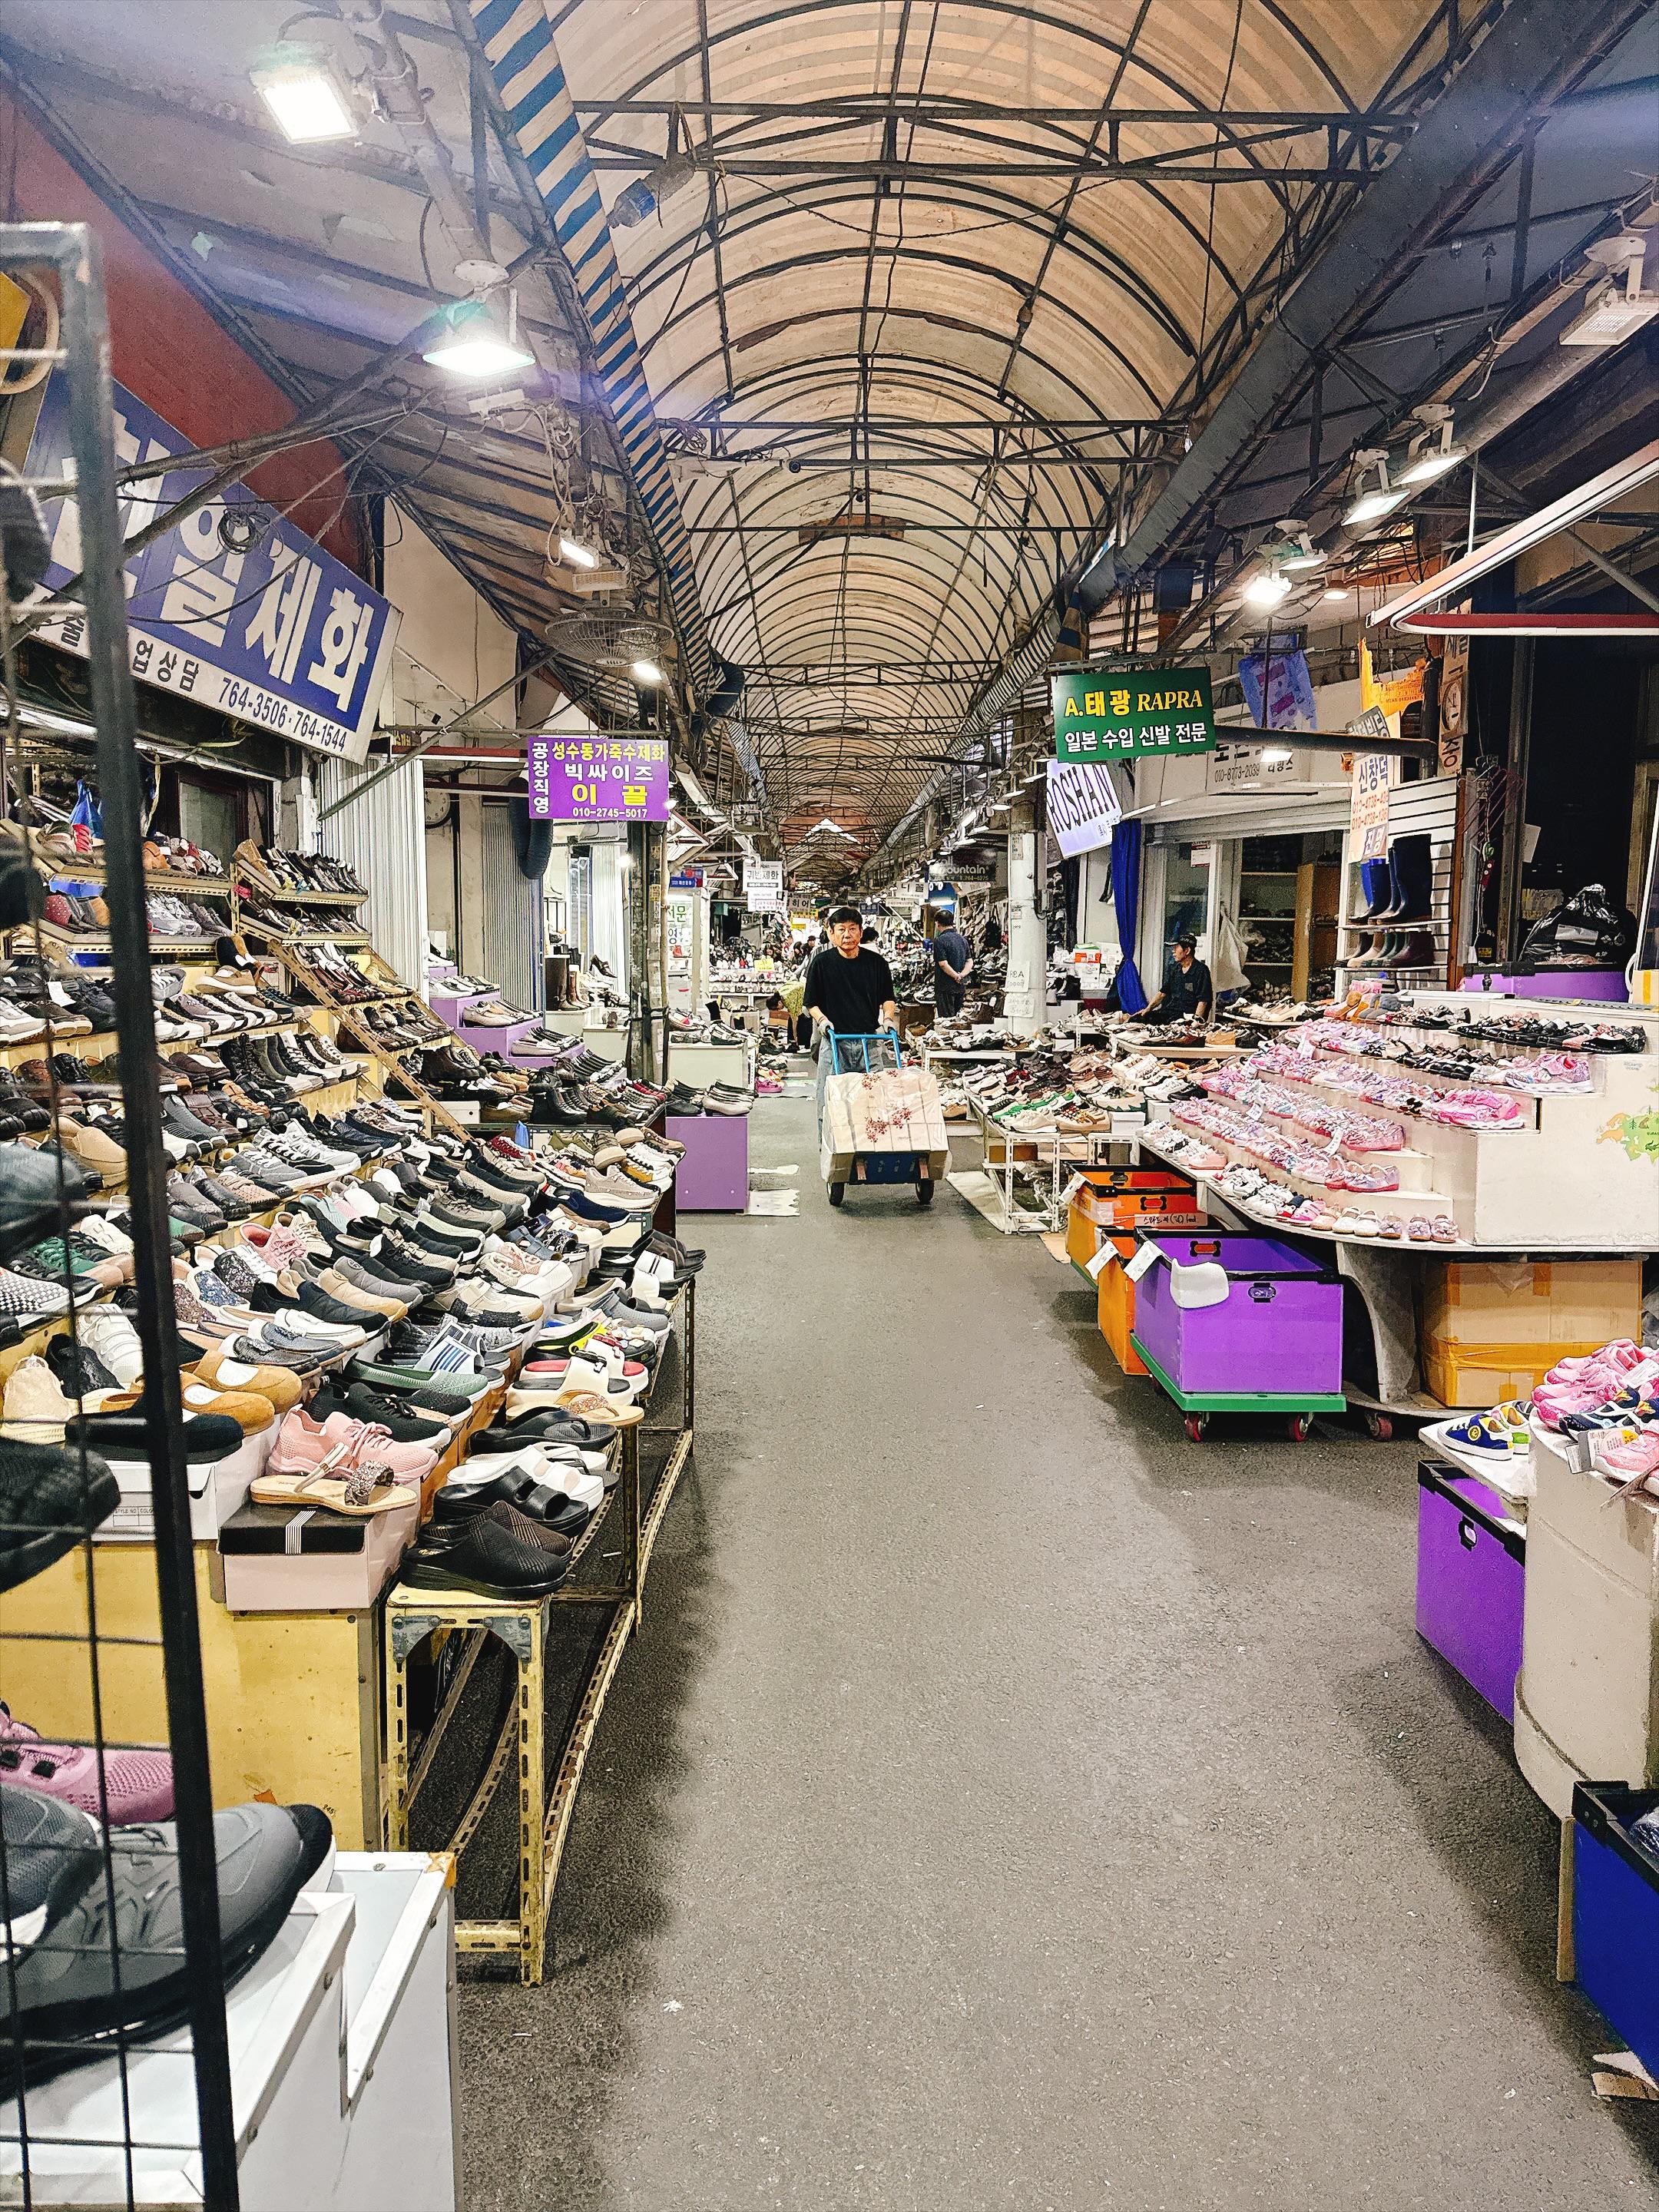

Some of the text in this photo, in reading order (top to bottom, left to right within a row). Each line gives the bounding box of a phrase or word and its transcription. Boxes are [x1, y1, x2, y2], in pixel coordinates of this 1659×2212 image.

[1136, 690, 1204, 713] RAPRA
[1065, 721, 1207, 753] 일본 수입 신발 전문
[551, 740, 665, 763] 성수동가죽수제화
[531, 742, 550, 815] 공장직영
[565, 763, 654, 782] 빅싸이즈
[572, 806, 648, 818] 010-2745-5017
[935, 865, 986, 874] ountain
